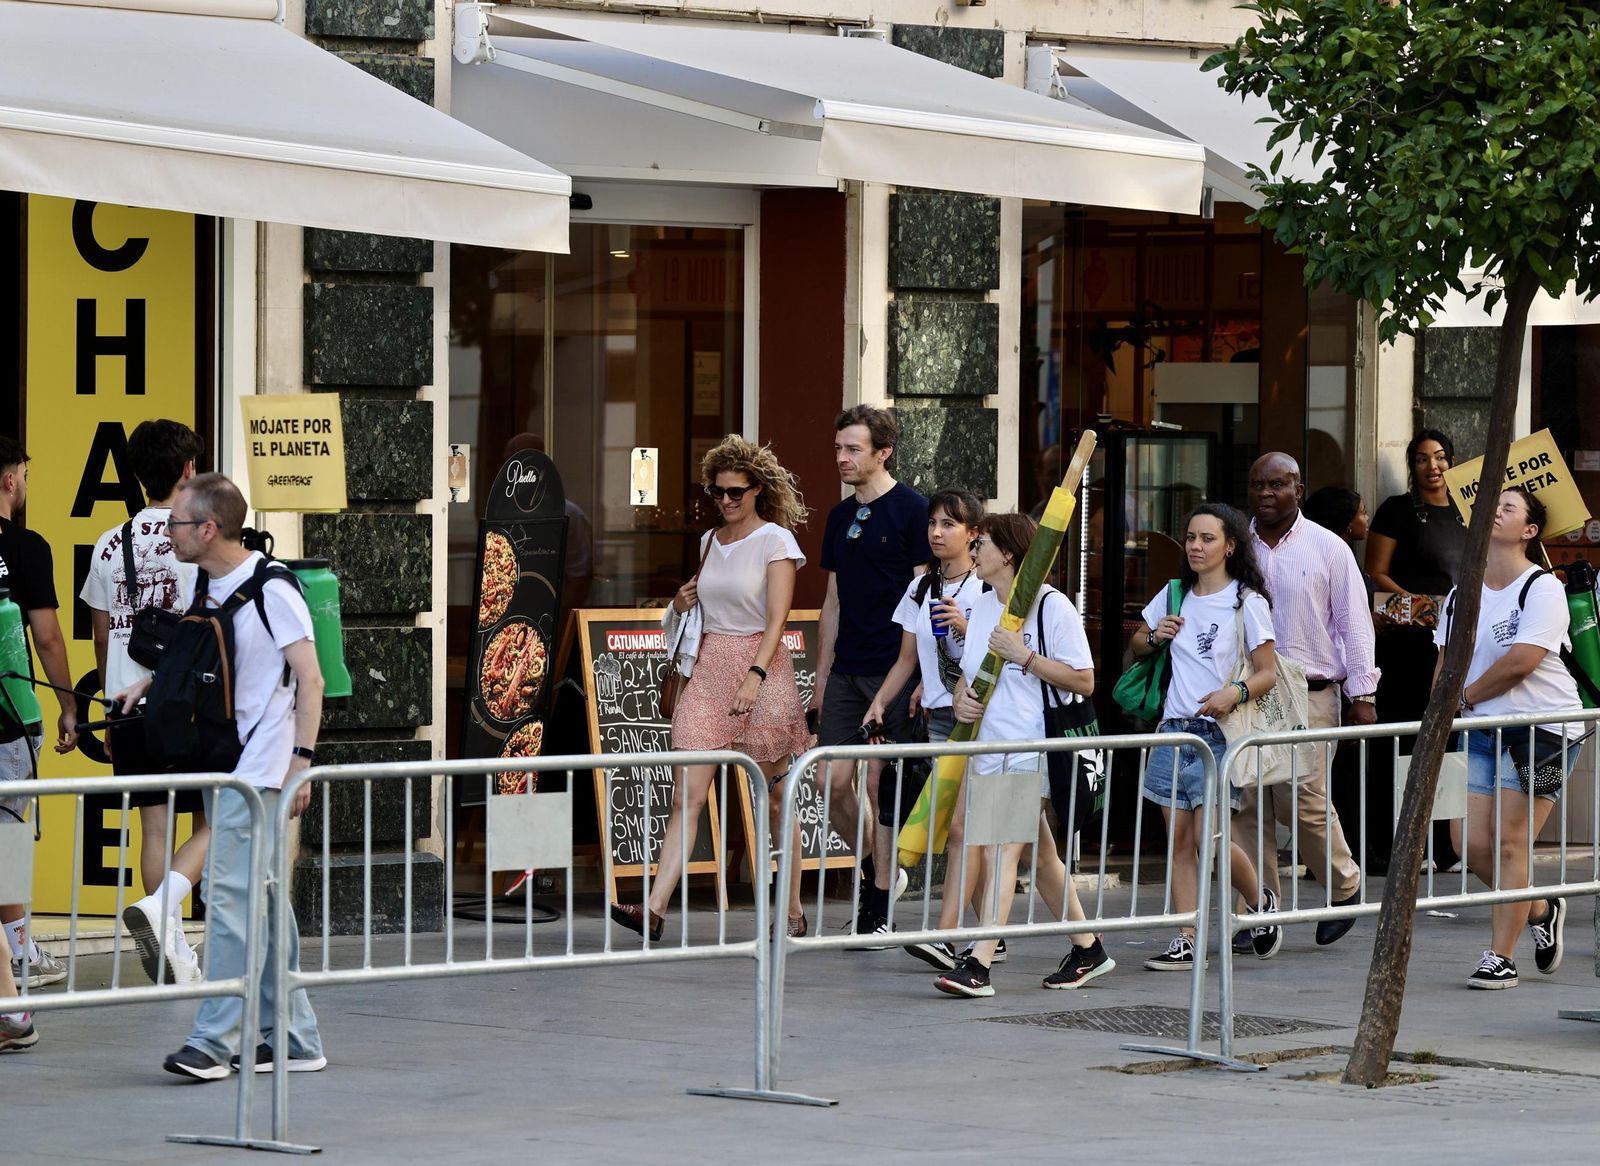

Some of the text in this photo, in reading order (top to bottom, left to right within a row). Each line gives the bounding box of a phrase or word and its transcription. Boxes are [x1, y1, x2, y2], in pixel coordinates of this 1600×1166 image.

[250, 416, 331, 434] MÓJATE POR
[252, 441, 330, 456] EL PLANETA
[267, 475, 313, 487] GREENPEACE
[506, 460, 537, 497] Paella
[1460, 467, 1517, 500] MÓE
[1518, 452, 1552, 475] POR
[1518, 471, 1558, 493] NETA
[71, 198, 150, 886] CHAE
[607, 632, 668, 650] CATUNAMBÚ
